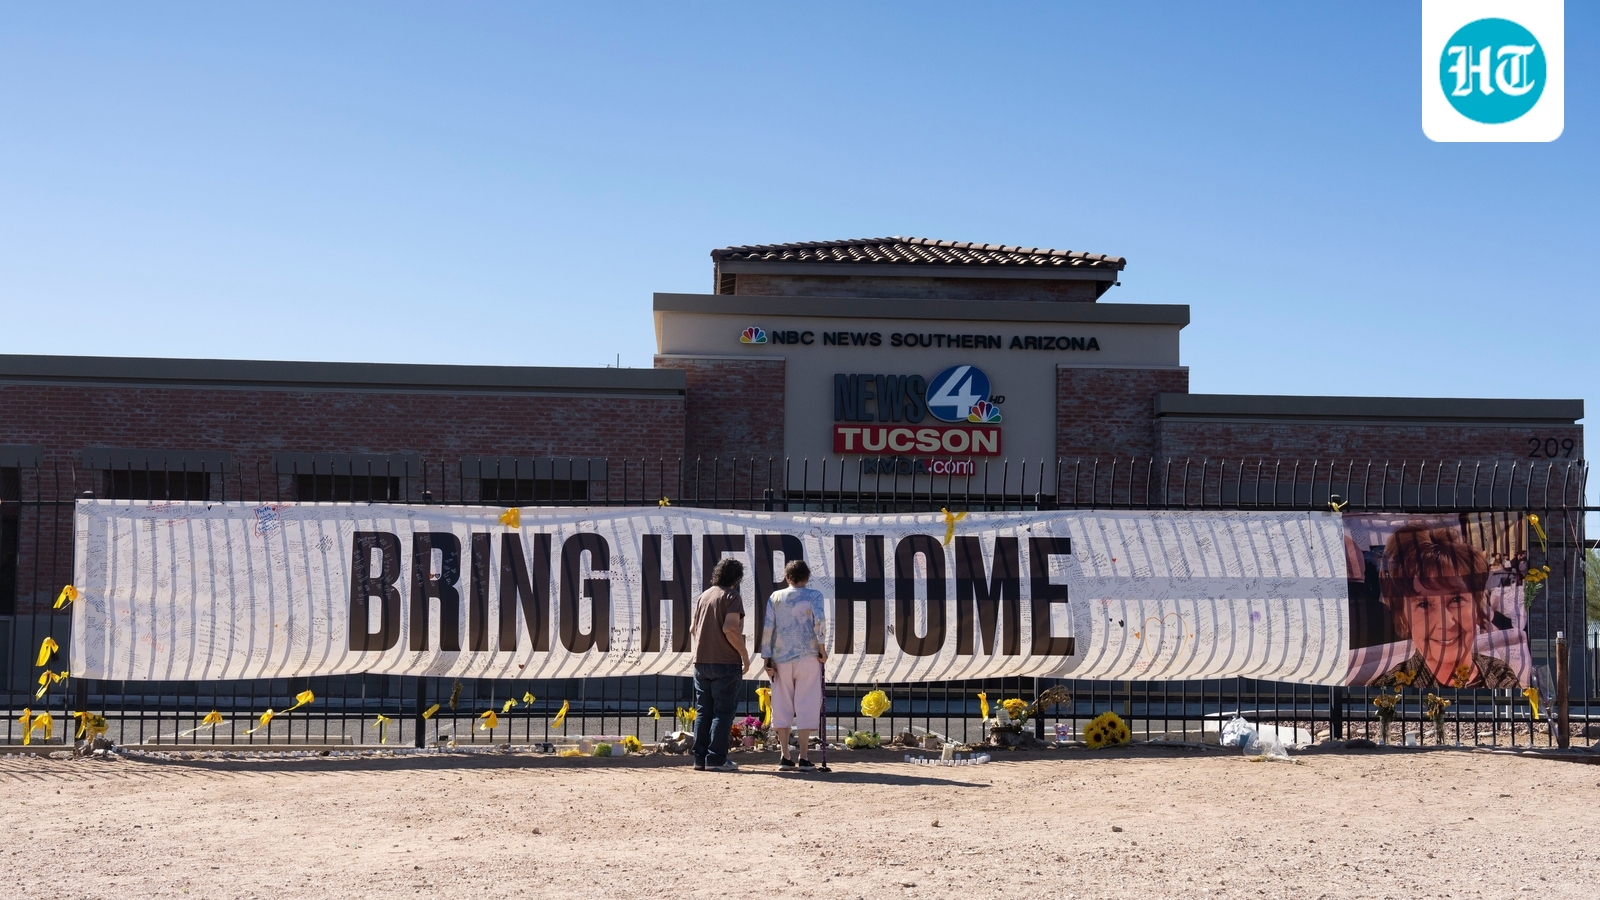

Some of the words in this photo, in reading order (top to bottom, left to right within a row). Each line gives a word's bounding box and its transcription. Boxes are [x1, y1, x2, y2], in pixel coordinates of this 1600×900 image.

[772, 330, 815, 346] NBC
[823, 331, 883, 347] NEWS
[890, 332, 1002, 350] SOUTHERN
[1008, 335, 1101, 352] ARIZONA
[833, 373, 926, 423] NEWS
[928, 366, 982, 419] 4
[989, 395, 1006, 405] HD
[837, 427, 998, 453] TUCSON
[1527, 437, 1575, 459] 209
[349, 531, 610, 653] BRING
[834, 533, 1075, 657] HOME
